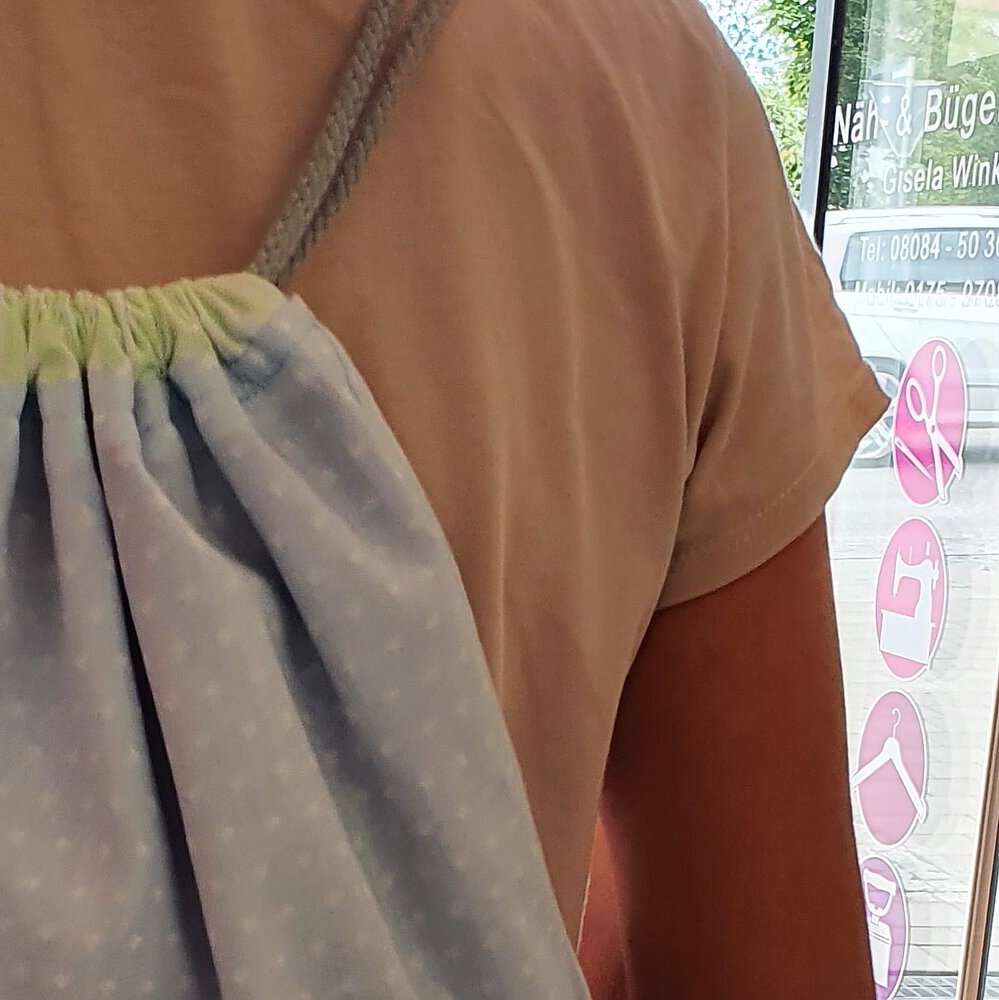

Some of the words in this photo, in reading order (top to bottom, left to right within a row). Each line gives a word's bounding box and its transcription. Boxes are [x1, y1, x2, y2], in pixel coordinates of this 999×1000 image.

[896, 94, 912, 137] &
[923, 84, 999, 140] Büge
[883, 159, 943, 194] Gisela
[860, 236, 885, 261] Tel:
[890, 232, 941, 260] 08084
[956, 230, 980, 259] 50
